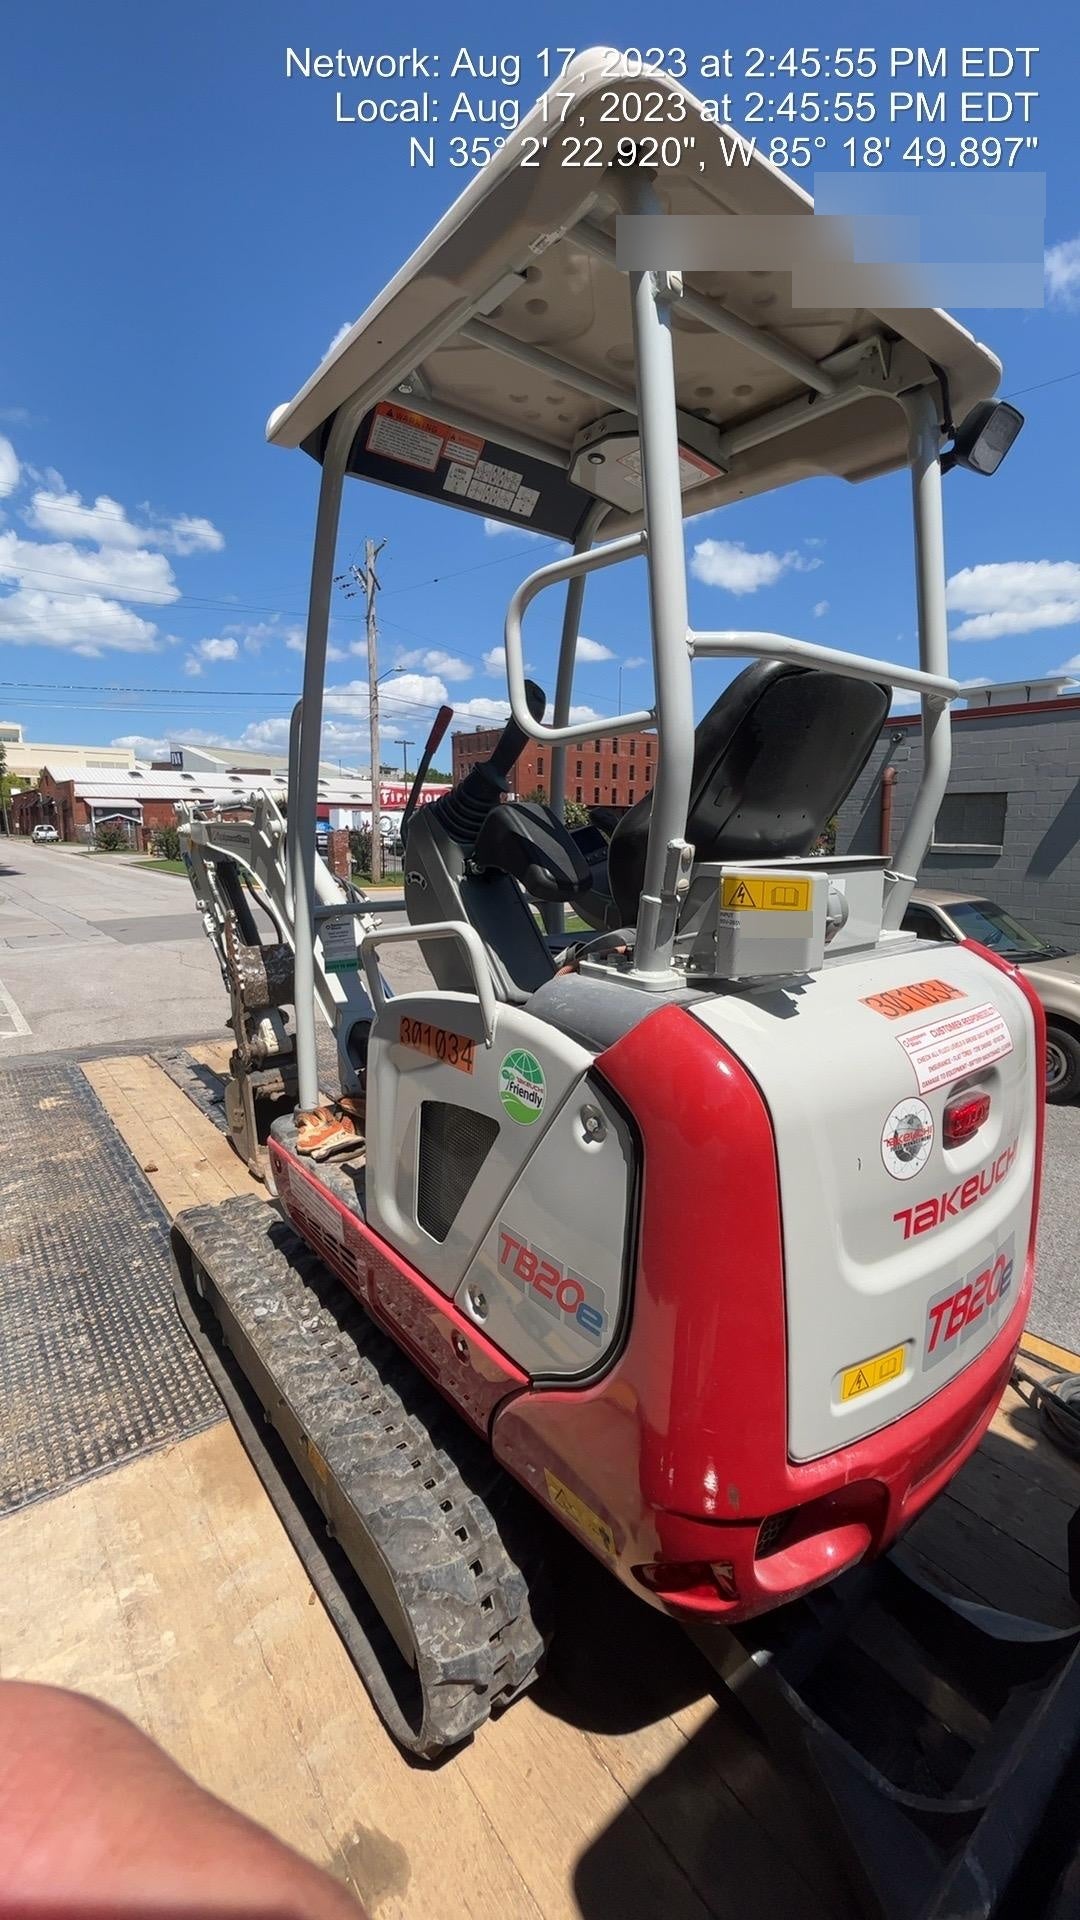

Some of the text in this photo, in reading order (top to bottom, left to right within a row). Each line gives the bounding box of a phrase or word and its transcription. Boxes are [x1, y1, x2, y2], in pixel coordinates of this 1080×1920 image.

[380, 788, 442, 806] Fireto
[865, 979, 961, 1017] 301034
[400, 1015, 473, 1071] 301034
[930, 1020, 961, 1038] CUSTOMER
[499, 1231, 604, 1337] TB20e
[926, 1253, 1014, 1354] TB20e
